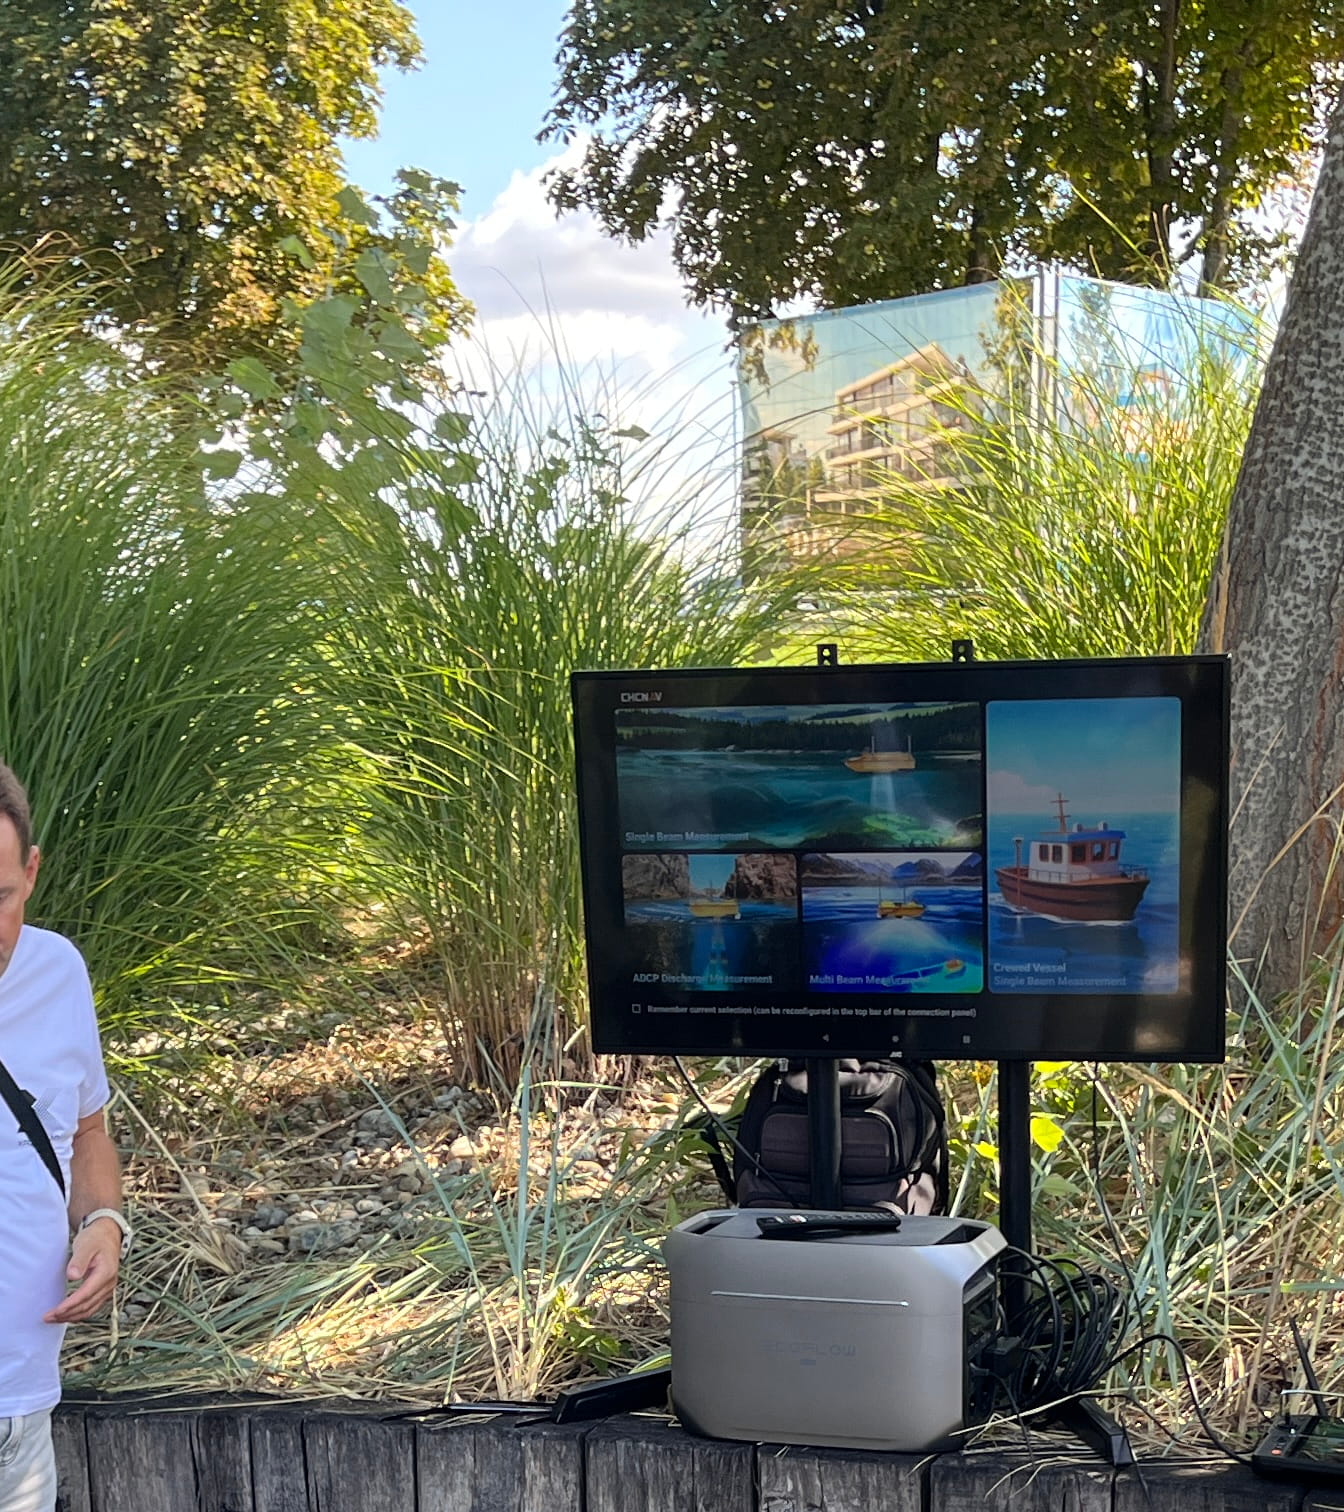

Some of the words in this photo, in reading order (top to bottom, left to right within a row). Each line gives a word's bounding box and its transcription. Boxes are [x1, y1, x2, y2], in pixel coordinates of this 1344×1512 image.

[625, 832, 654, 843] Single
[657, 832, 683, 841] Beam
[685, 832, 749, 841] Measurement
[993, 962, 1030, 972] Crewed
[1033, 963, 1066, 973] Vessel
[633, 973, 658, 983] ADCP
[710, 974, 773, 984] Measurement
[809, 974, 835, 984] Multi
[837, 975, 863, 985] Beam
[994, 975, 1025, 987] Single
[1027, 976, 1055, 986] Beam
[1058, 976, 1127, 987] Measurement
[647, 1004, 688, 1014] Remember
[689, 1006, 716, 1014] current
[718, 1006, 752, 1015] selection
[771, 1006, 781, 1015] be
[855, 1008, 867, 1017] top
[869, 1008, 882, 1016] bar
[883, 1008, 892, 1016] of
[893, 1008, 906, 1016] the
[907, 1008, 950, 1017] connection
